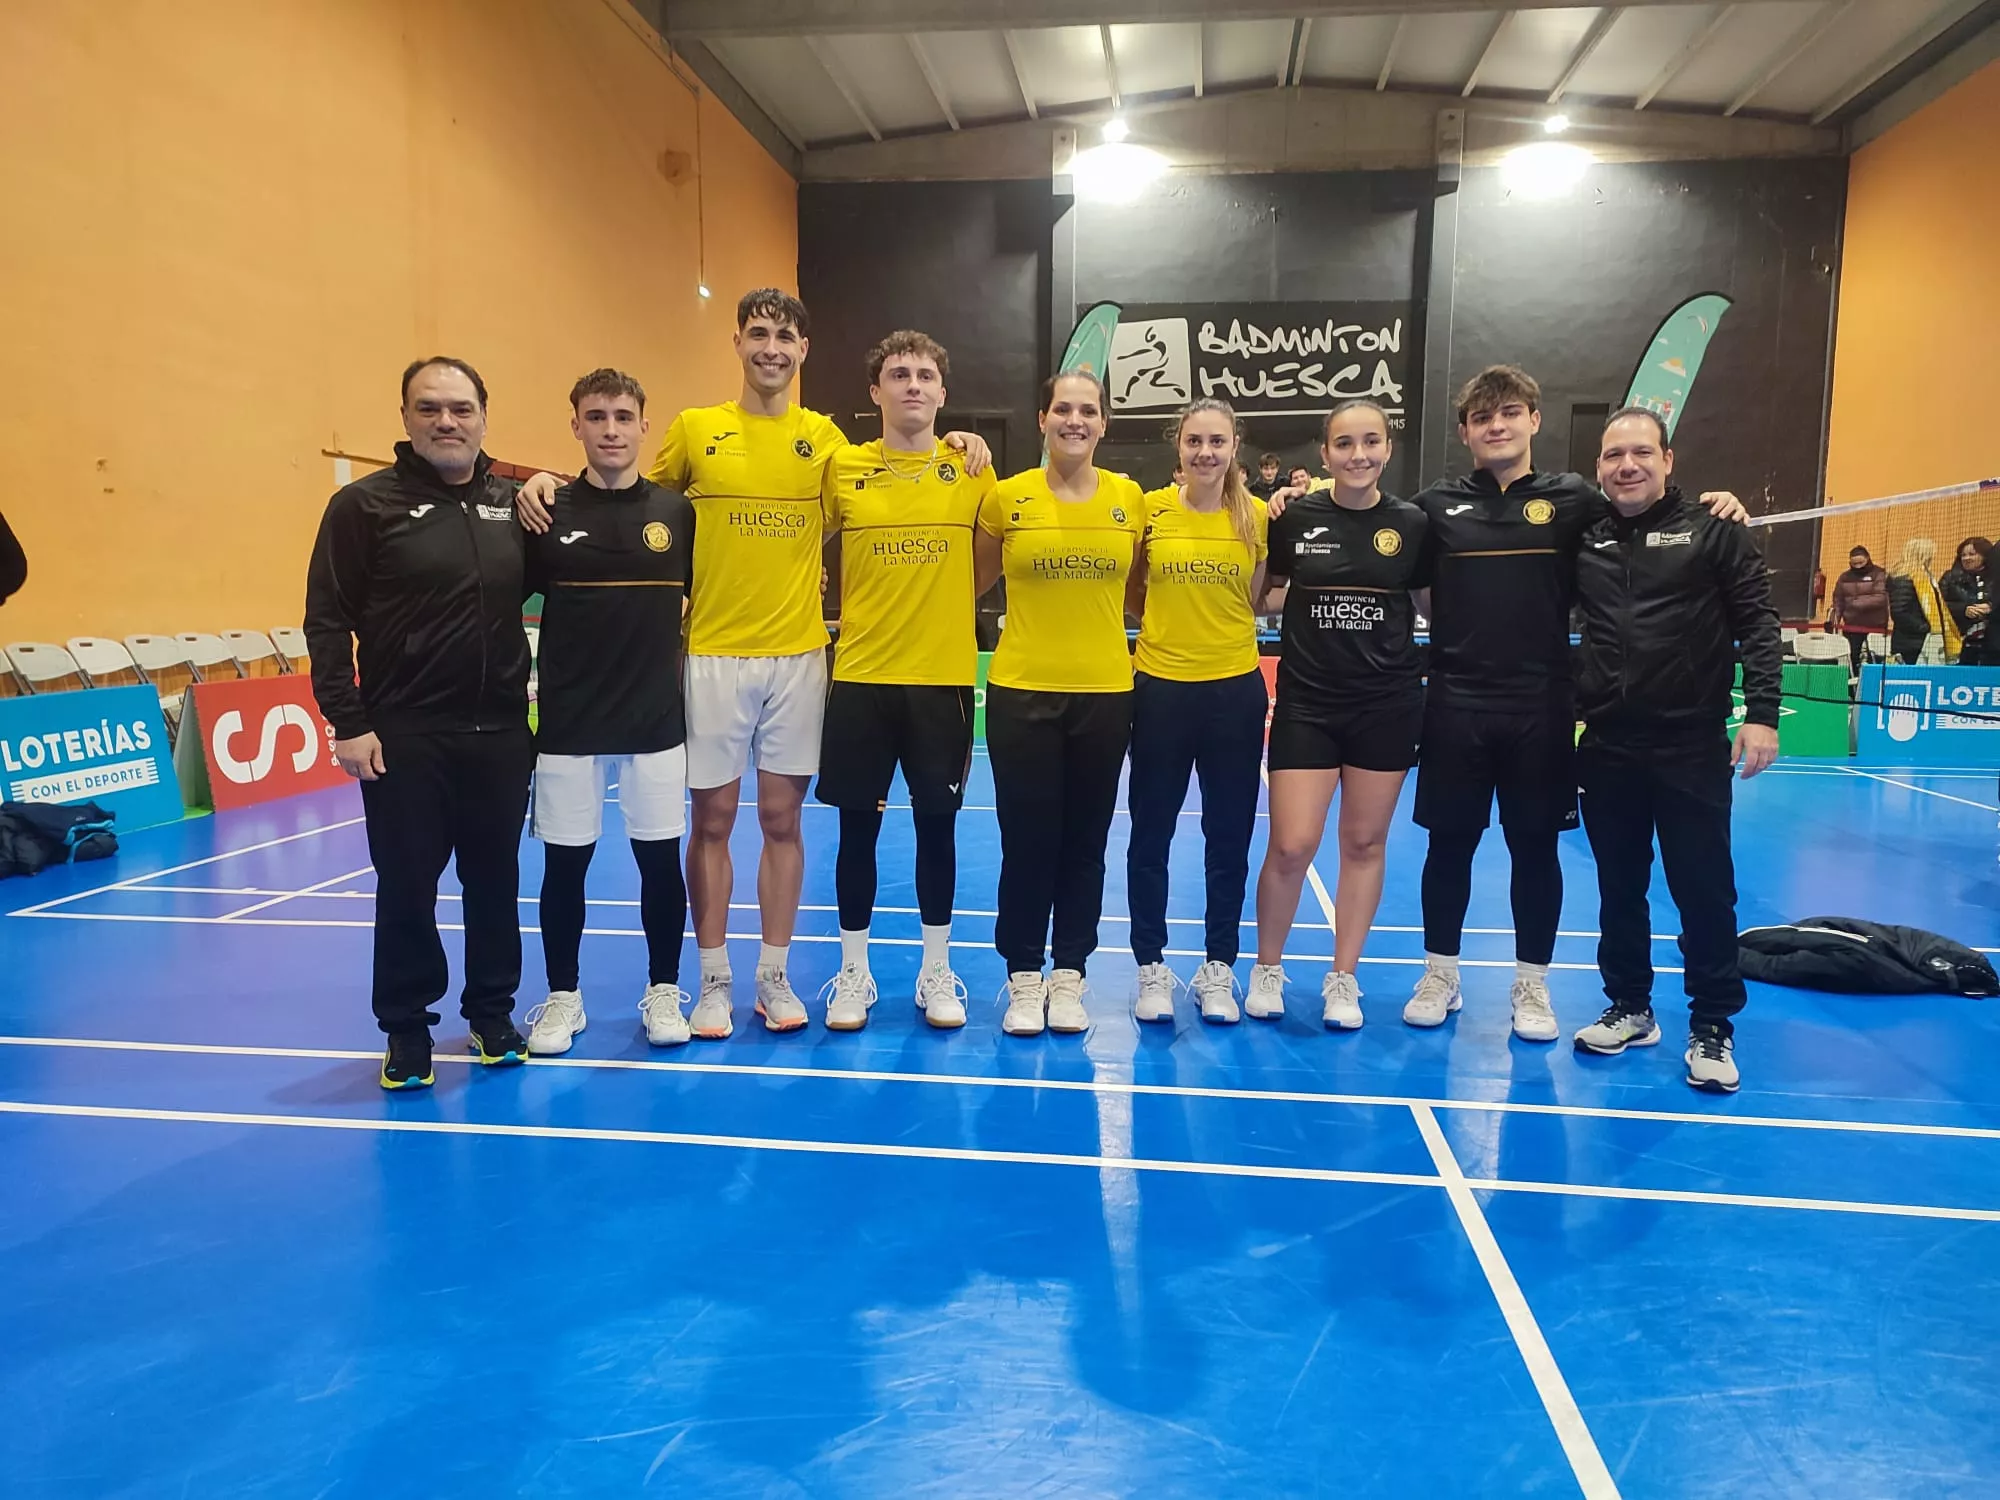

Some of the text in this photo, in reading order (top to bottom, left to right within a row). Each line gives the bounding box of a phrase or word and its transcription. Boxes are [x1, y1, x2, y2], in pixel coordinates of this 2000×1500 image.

[1199, 359, 1402, 402] HUESCA
[728, 510, 806, 528] Huesca
[872, 538, 949, 556] Huesca
[1033, 553, 1117, 571] Huesca
[1162, 558, 1240, 577] Huesca
[1310, 602, 1384, 621] Huesca
[1, 718, 152, 772] LOTERÍAS
[30, 767, 143, 799] CON EL DEPORTE
